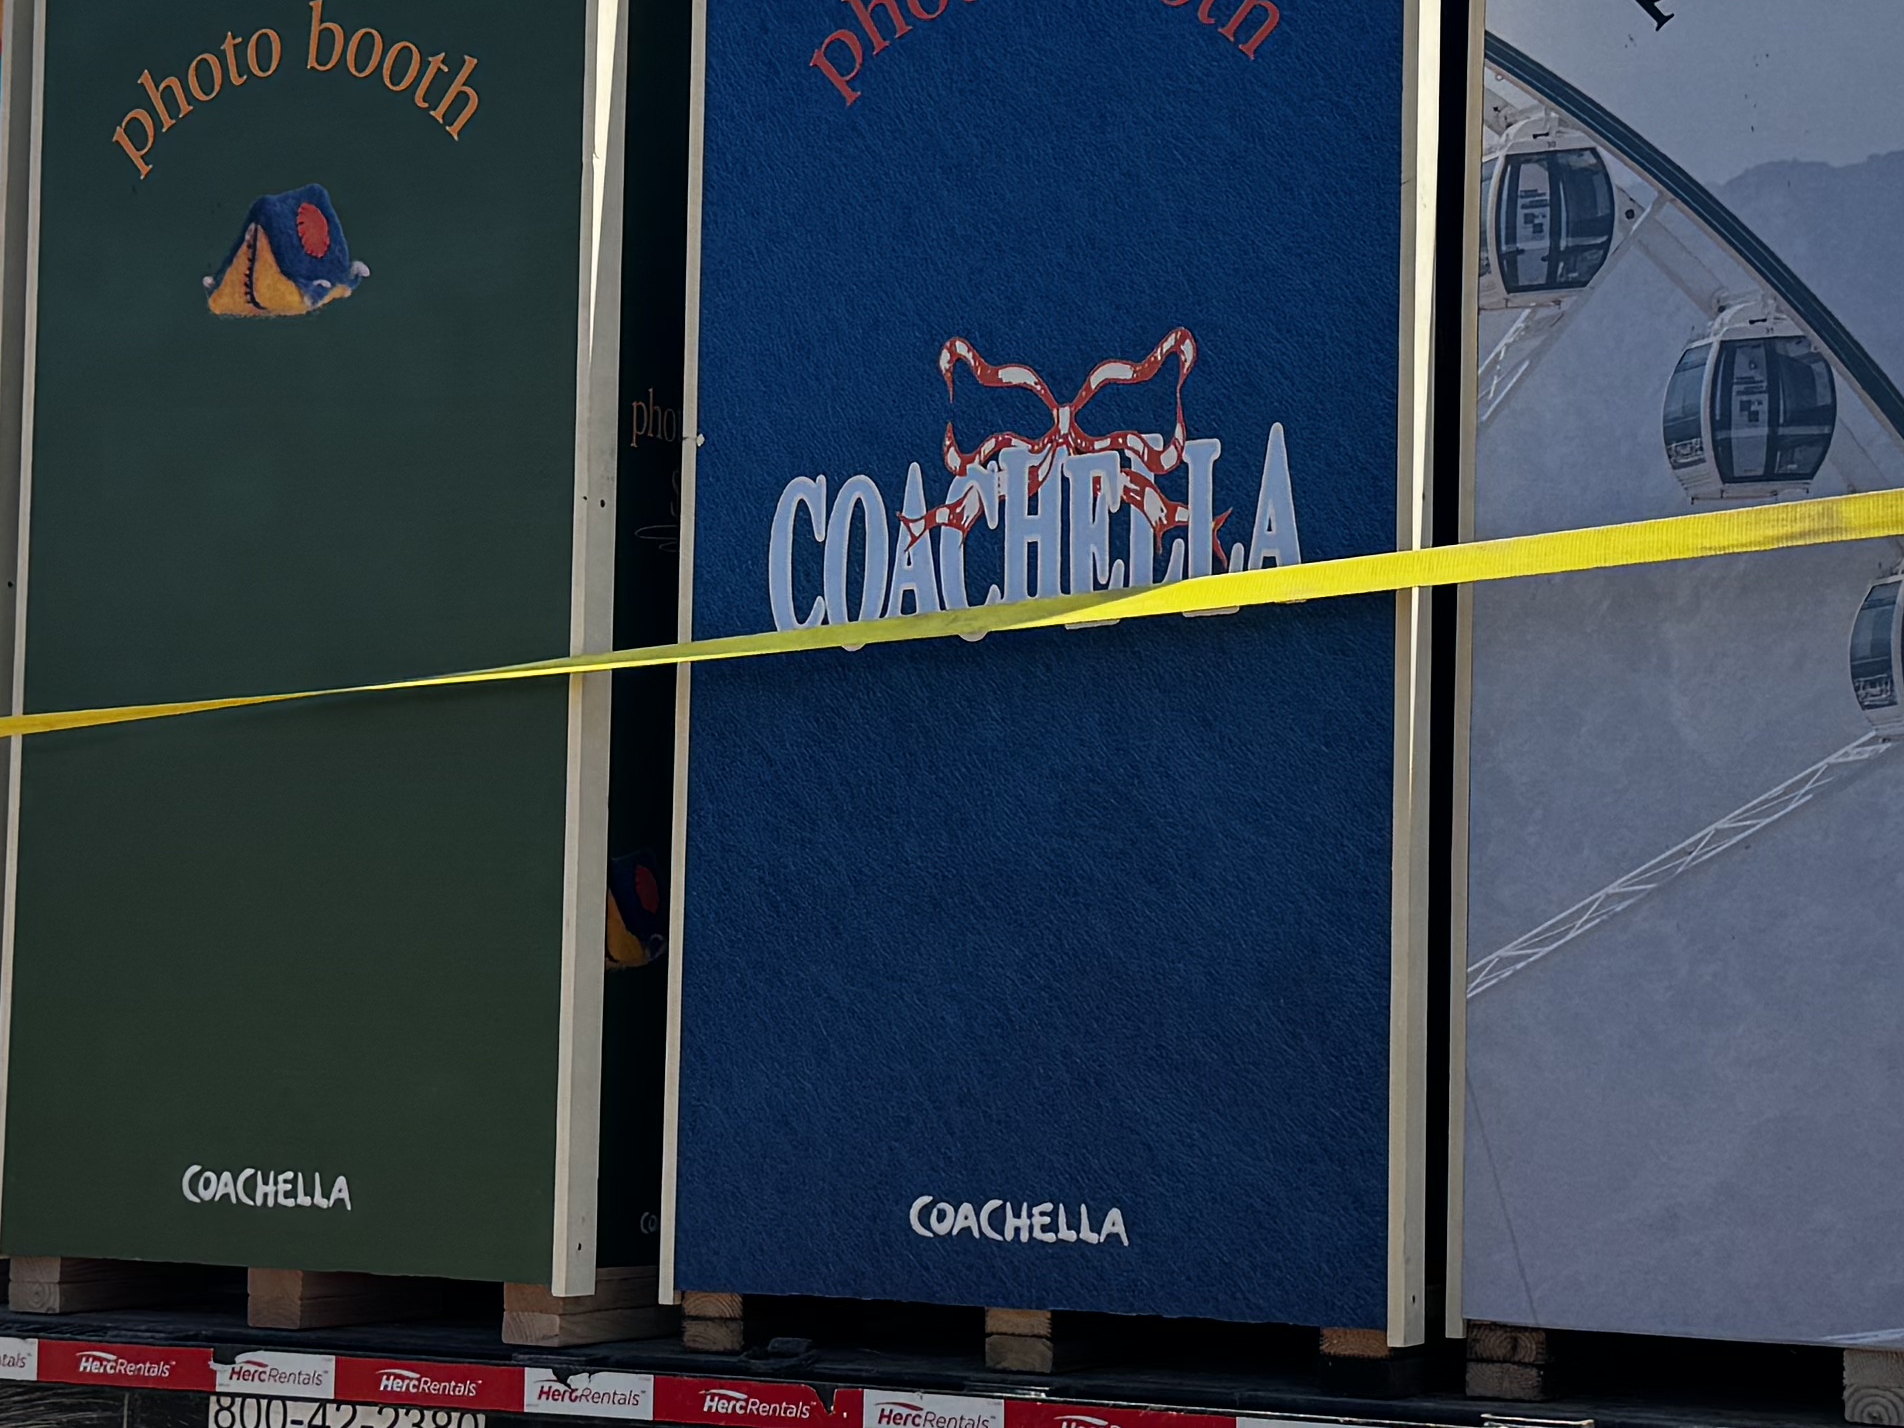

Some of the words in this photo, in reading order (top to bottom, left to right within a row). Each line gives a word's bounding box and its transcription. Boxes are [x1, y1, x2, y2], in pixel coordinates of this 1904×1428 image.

[111, 26, 282, 180] photo
[181, 1164, 352, 1211] COACHELLA
[909, 1194, 1130, 1247] COACHELLA
